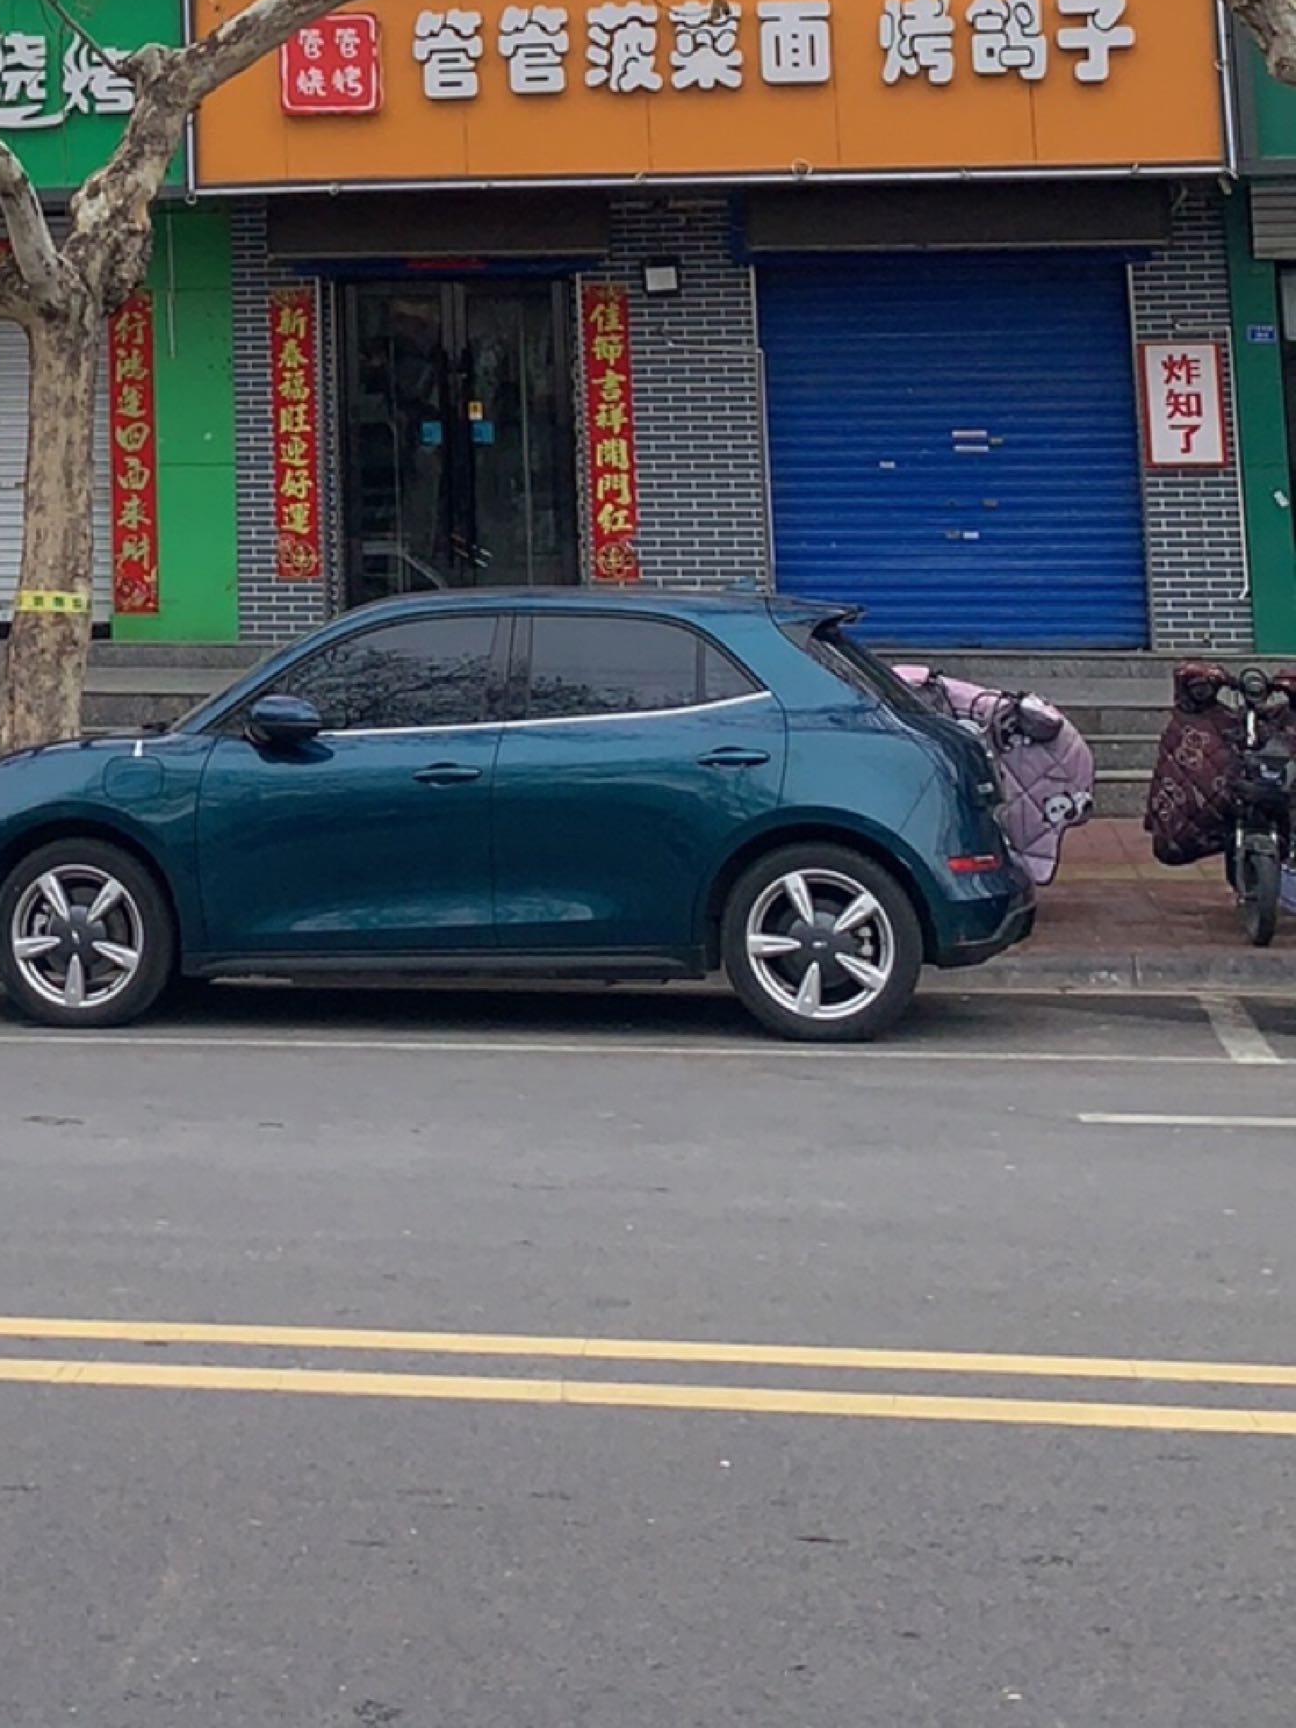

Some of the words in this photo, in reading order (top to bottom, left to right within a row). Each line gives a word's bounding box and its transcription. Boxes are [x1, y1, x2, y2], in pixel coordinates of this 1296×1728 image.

[297, 27, 360, 60] 管管
[412, 0, 833, 101] 管管菠菜面
[296, 65, 364, 97] 烧烤
[1160, 353, 1203, 455] 炸知了
